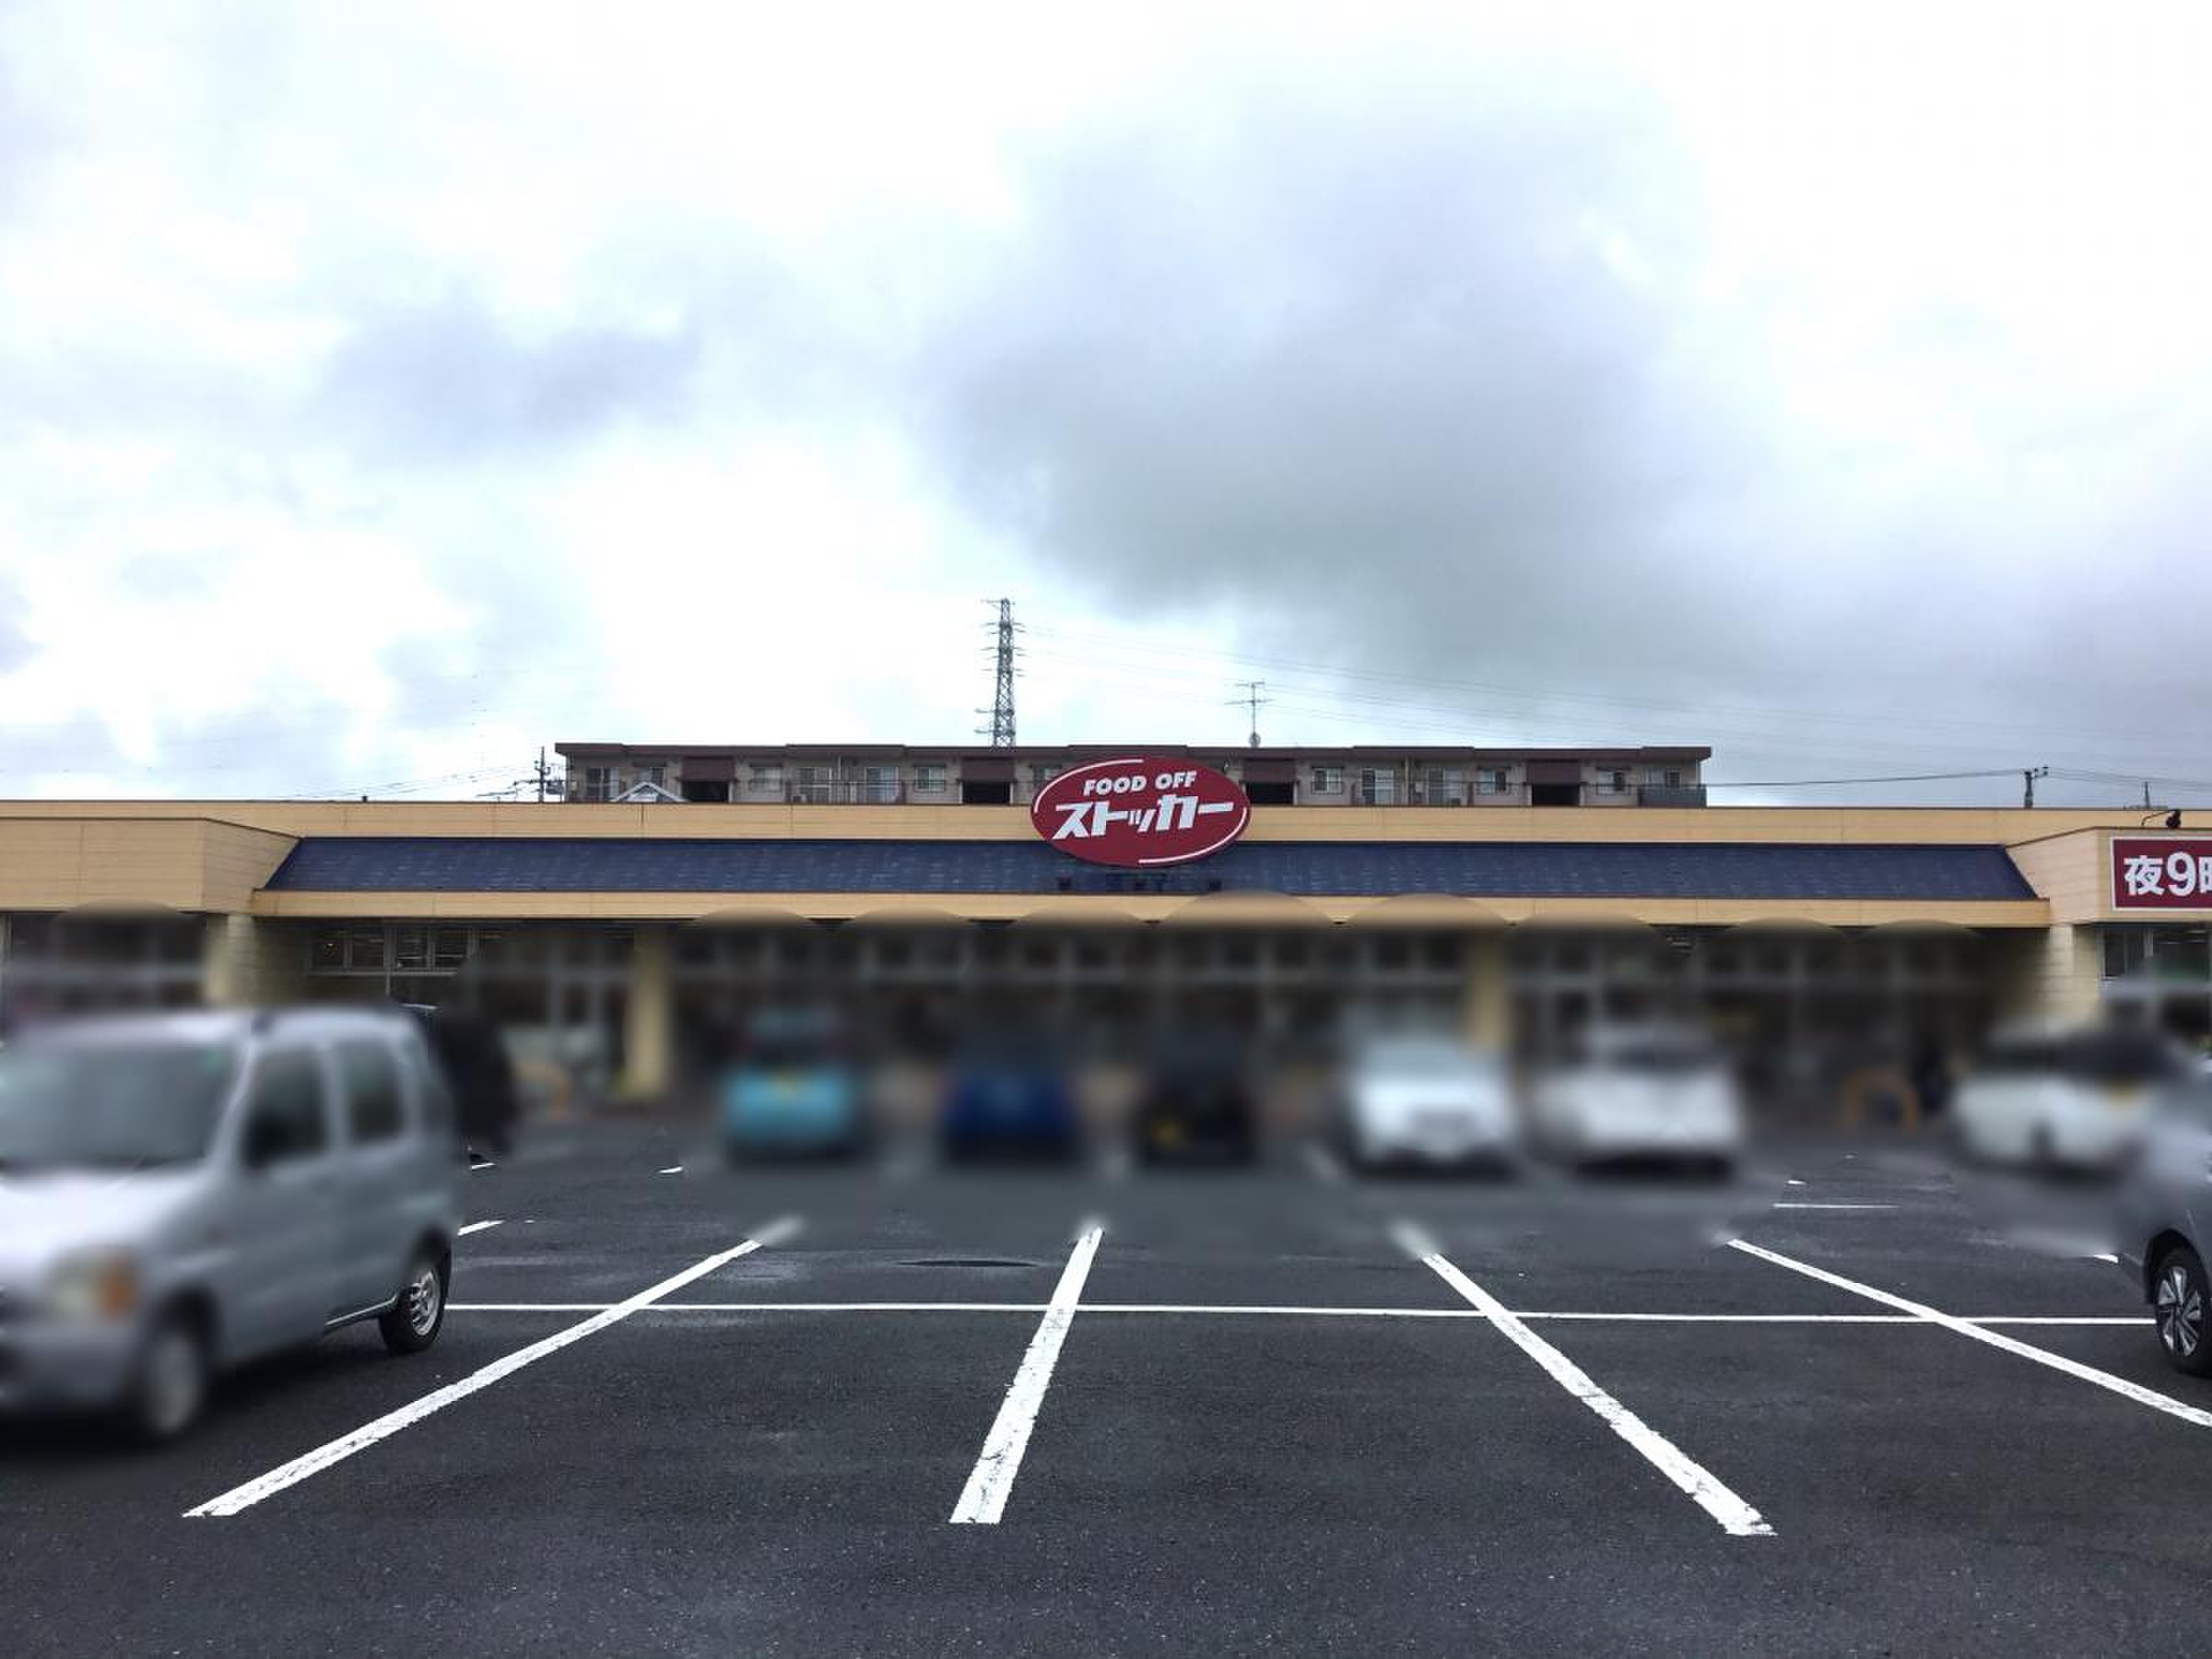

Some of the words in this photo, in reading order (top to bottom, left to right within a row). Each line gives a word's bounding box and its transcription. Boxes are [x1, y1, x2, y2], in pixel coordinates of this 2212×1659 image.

[1083, 775, 1147, 796] FOOD
[1155, 771, 1197, 790] OFF
[1052, 794, 1234, 840] ストッカー
